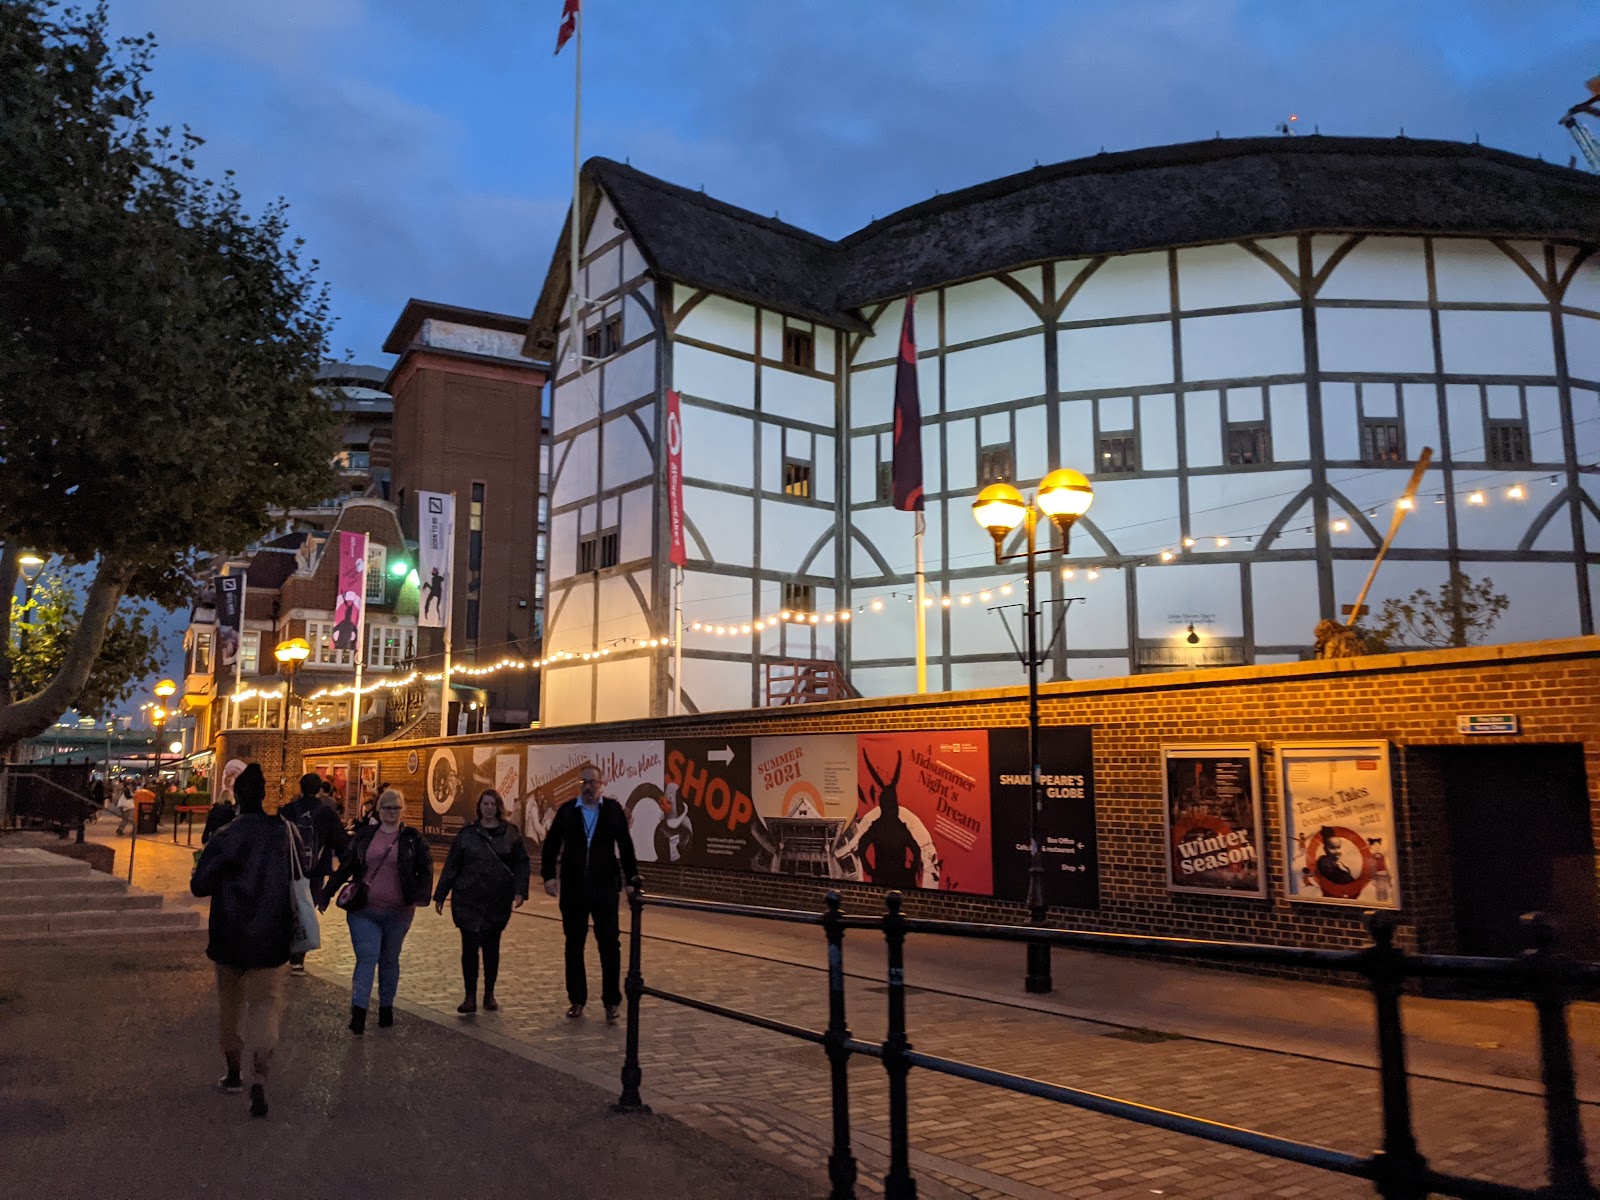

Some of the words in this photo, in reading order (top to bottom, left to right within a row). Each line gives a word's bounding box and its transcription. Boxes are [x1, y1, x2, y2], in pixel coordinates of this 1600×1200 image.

[757, 746, 804, 775] SUMMER
[910, 749, 976, 792] Midsummer
[664, 750, 753, 831] SHOP
[763, 762, 802, 791] 2021
[919, 770, 959, 803] Night's
[999, 774, 1085, 786] SHAKPEARE'S
[1046, 787, 1085, 799] GLOBE
[1336, 786, 1369, 803] Tales
[936, 796, 981, 833] Dream
[1177, 828, 1250, 859] winter
[1061, 864, 1077, 873] Shop
[1180, 843, 1258, 875] season
